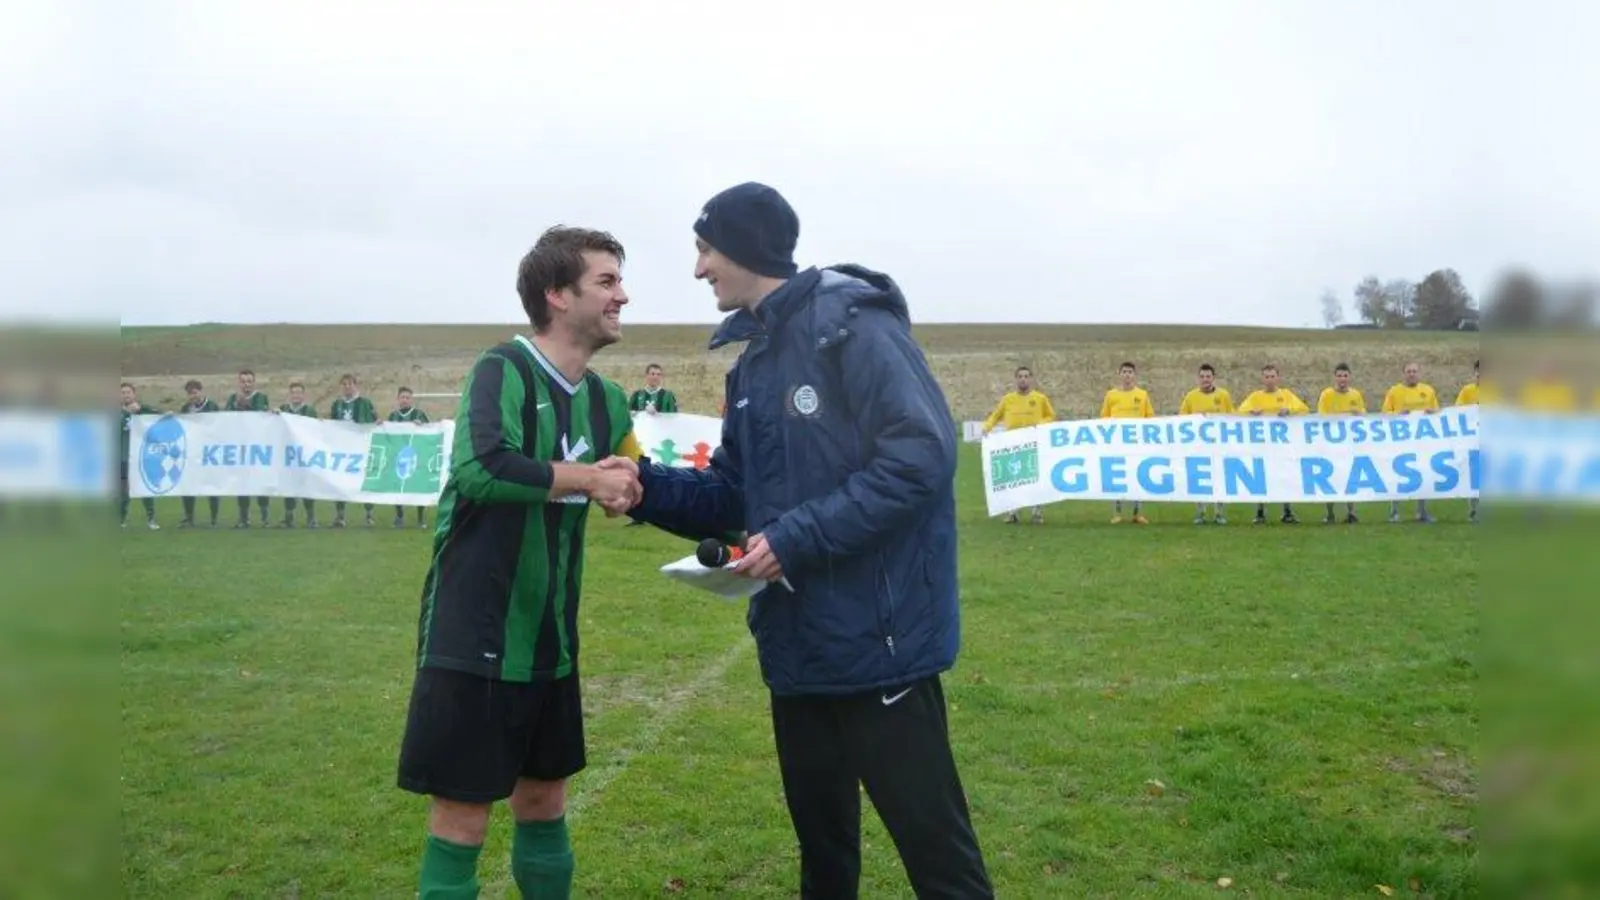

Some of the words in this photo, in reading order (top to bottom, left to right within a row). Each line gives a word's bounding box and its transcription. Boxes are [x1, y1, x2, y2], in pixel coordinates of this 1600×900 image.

[1049, 418, 1290, 448] BAYERISCHER
[1302, 413, 1479, 445] FUSSBALL
[201, 443, 274, 468] KEIN
[284, 443, 364, 474] PLATZ
[1050, 455, 1269, 496] GEGEN
[1299, 448, 1479, 495] RASSI
